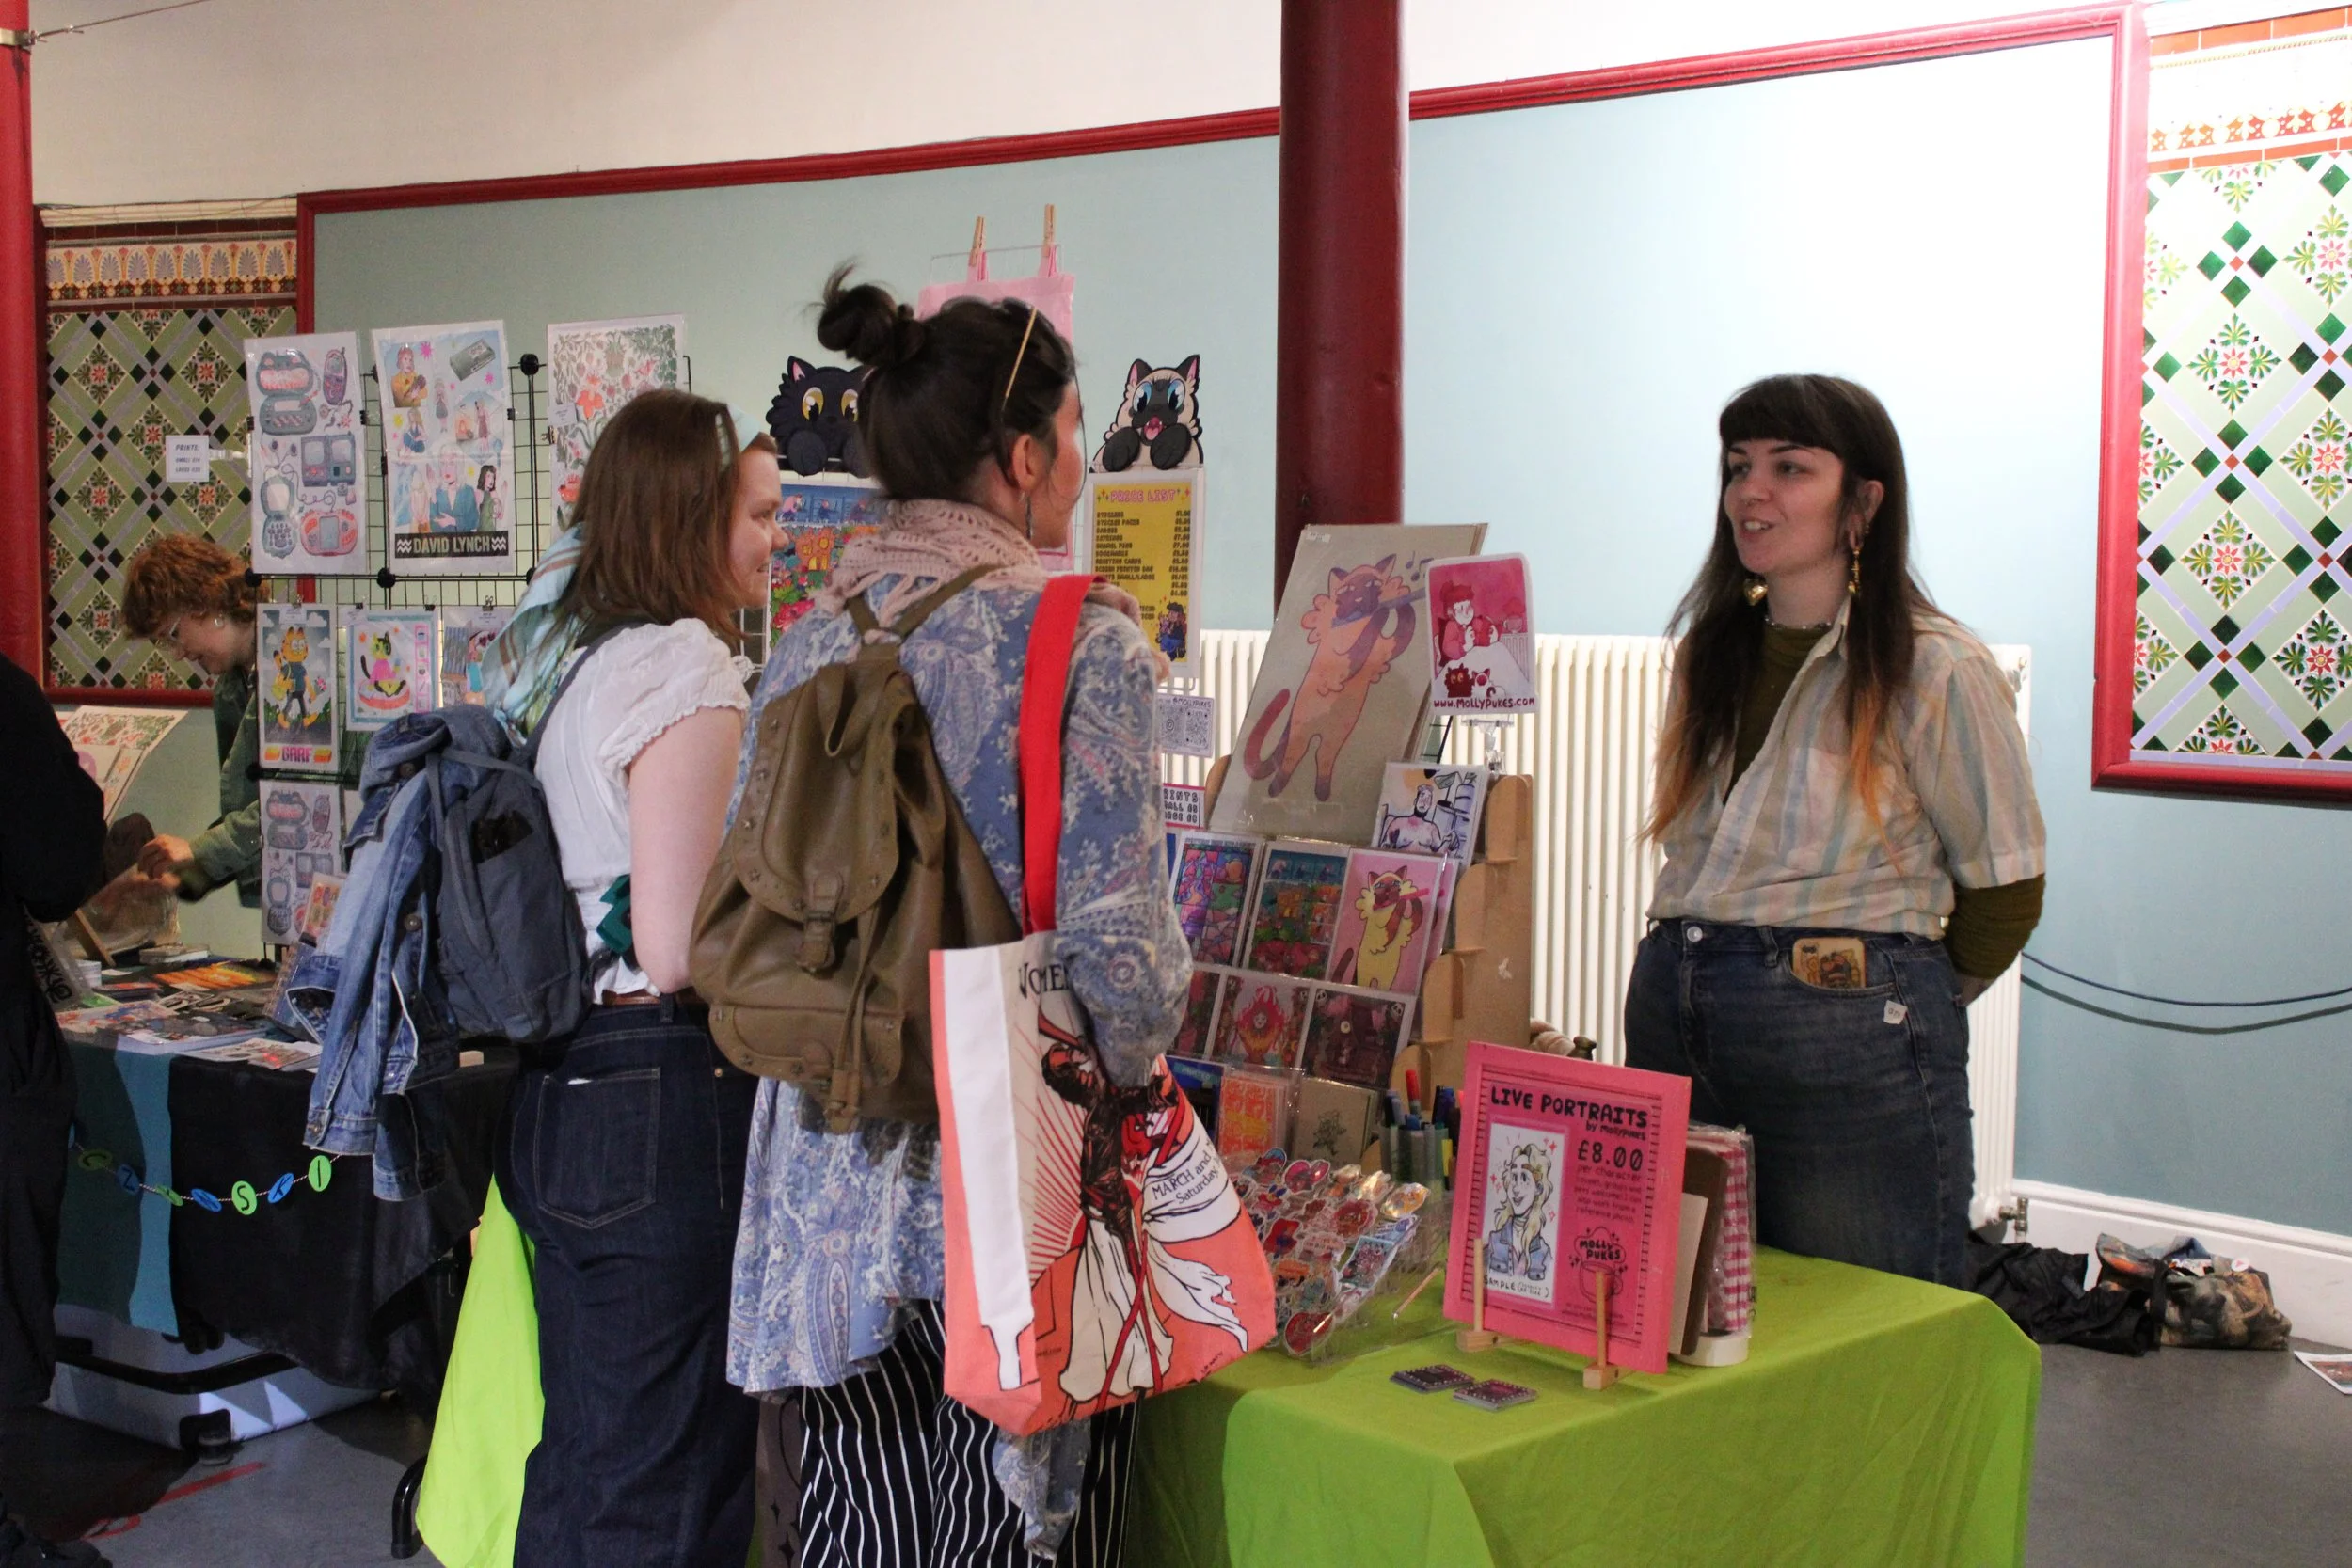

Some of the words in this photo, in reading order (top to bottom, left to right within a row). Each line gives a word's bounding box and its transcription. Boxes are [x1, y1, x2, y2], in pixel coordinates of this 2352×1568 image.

[1110, 489, 1144, 503] PRICE
[1148, 489, 1176, 502] LIST
[414, 537, 450, 554] DAVID
[453, 535, 490, 553] LYNCH
[1163, 788, 1199, 803] RINTS
[1491, 1085, 1534, 1110] LIVE
[1540, 1094, 1648, 1128] PORTRAITS
[1586, 1120, 1597, 1132] by
[1577, 1139, 1644, 1171] £8.00
[1152, 1169, 1195, 1200] MARCH
[1195, 1150, 1212, 1175] and
[1175, 1165, 1219, 1204] Saturday
[1580, 1239, 1613, 1251] MOLLY
[1586, 1248, 1621, 1260] PUKES
